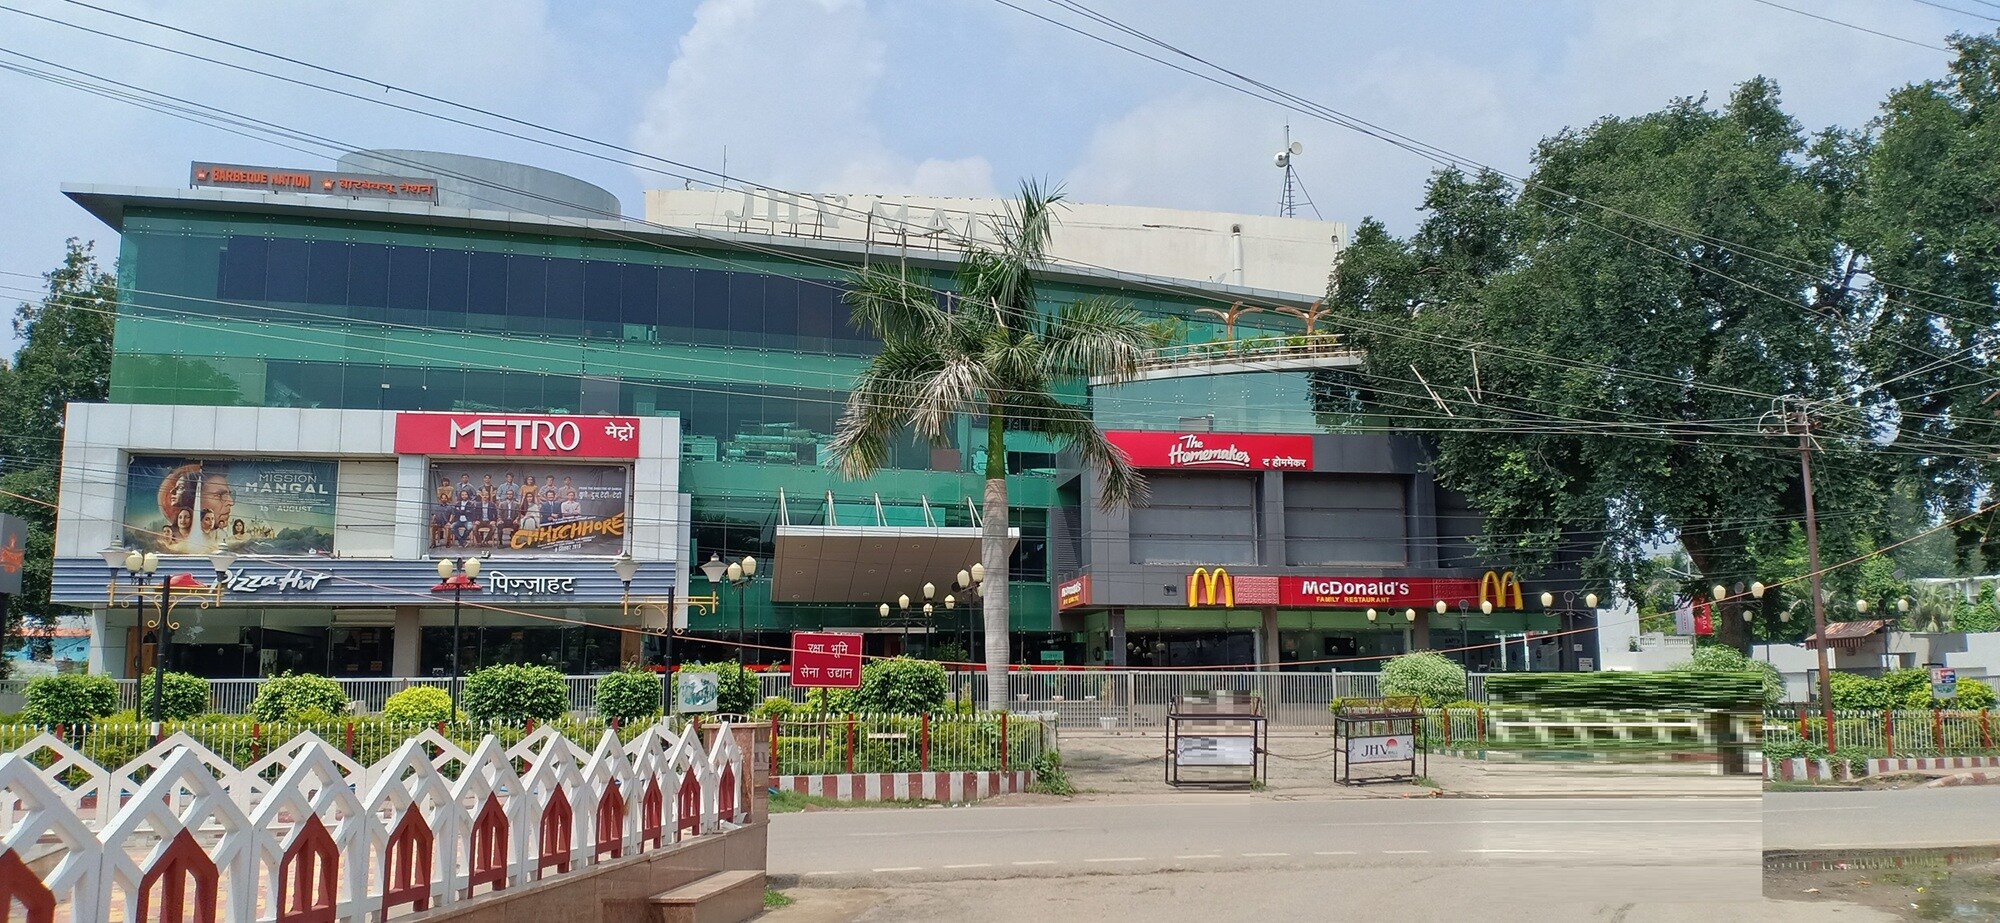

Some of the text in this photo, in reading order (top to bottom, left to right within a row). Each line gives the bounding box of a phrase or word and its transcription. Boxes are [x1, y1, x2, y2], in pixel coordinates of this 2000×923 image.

[212, 167, 310, 189] BARBEQUE NATION
[725, 185, 849, 229] JHV
[450, 418, 580, 451] METRO
[604, 421, 634, 441] मेट्रो
[1179, 434, 1203, 449] The
[1262, 455, 1307, 468] द होममेकर
[259, 474, 317, 484] MISSION
[245, 482, 329, 494] MANGAL
[278, 569, 331, 591] Hut
[1302, 580, 1409, 596] McDonald's
[807, 640, 848, 658] रक्षा भूमि
[800, 664, 853, 679] सेना उद्यान
[1361, 744, 1389, 757] JHV
